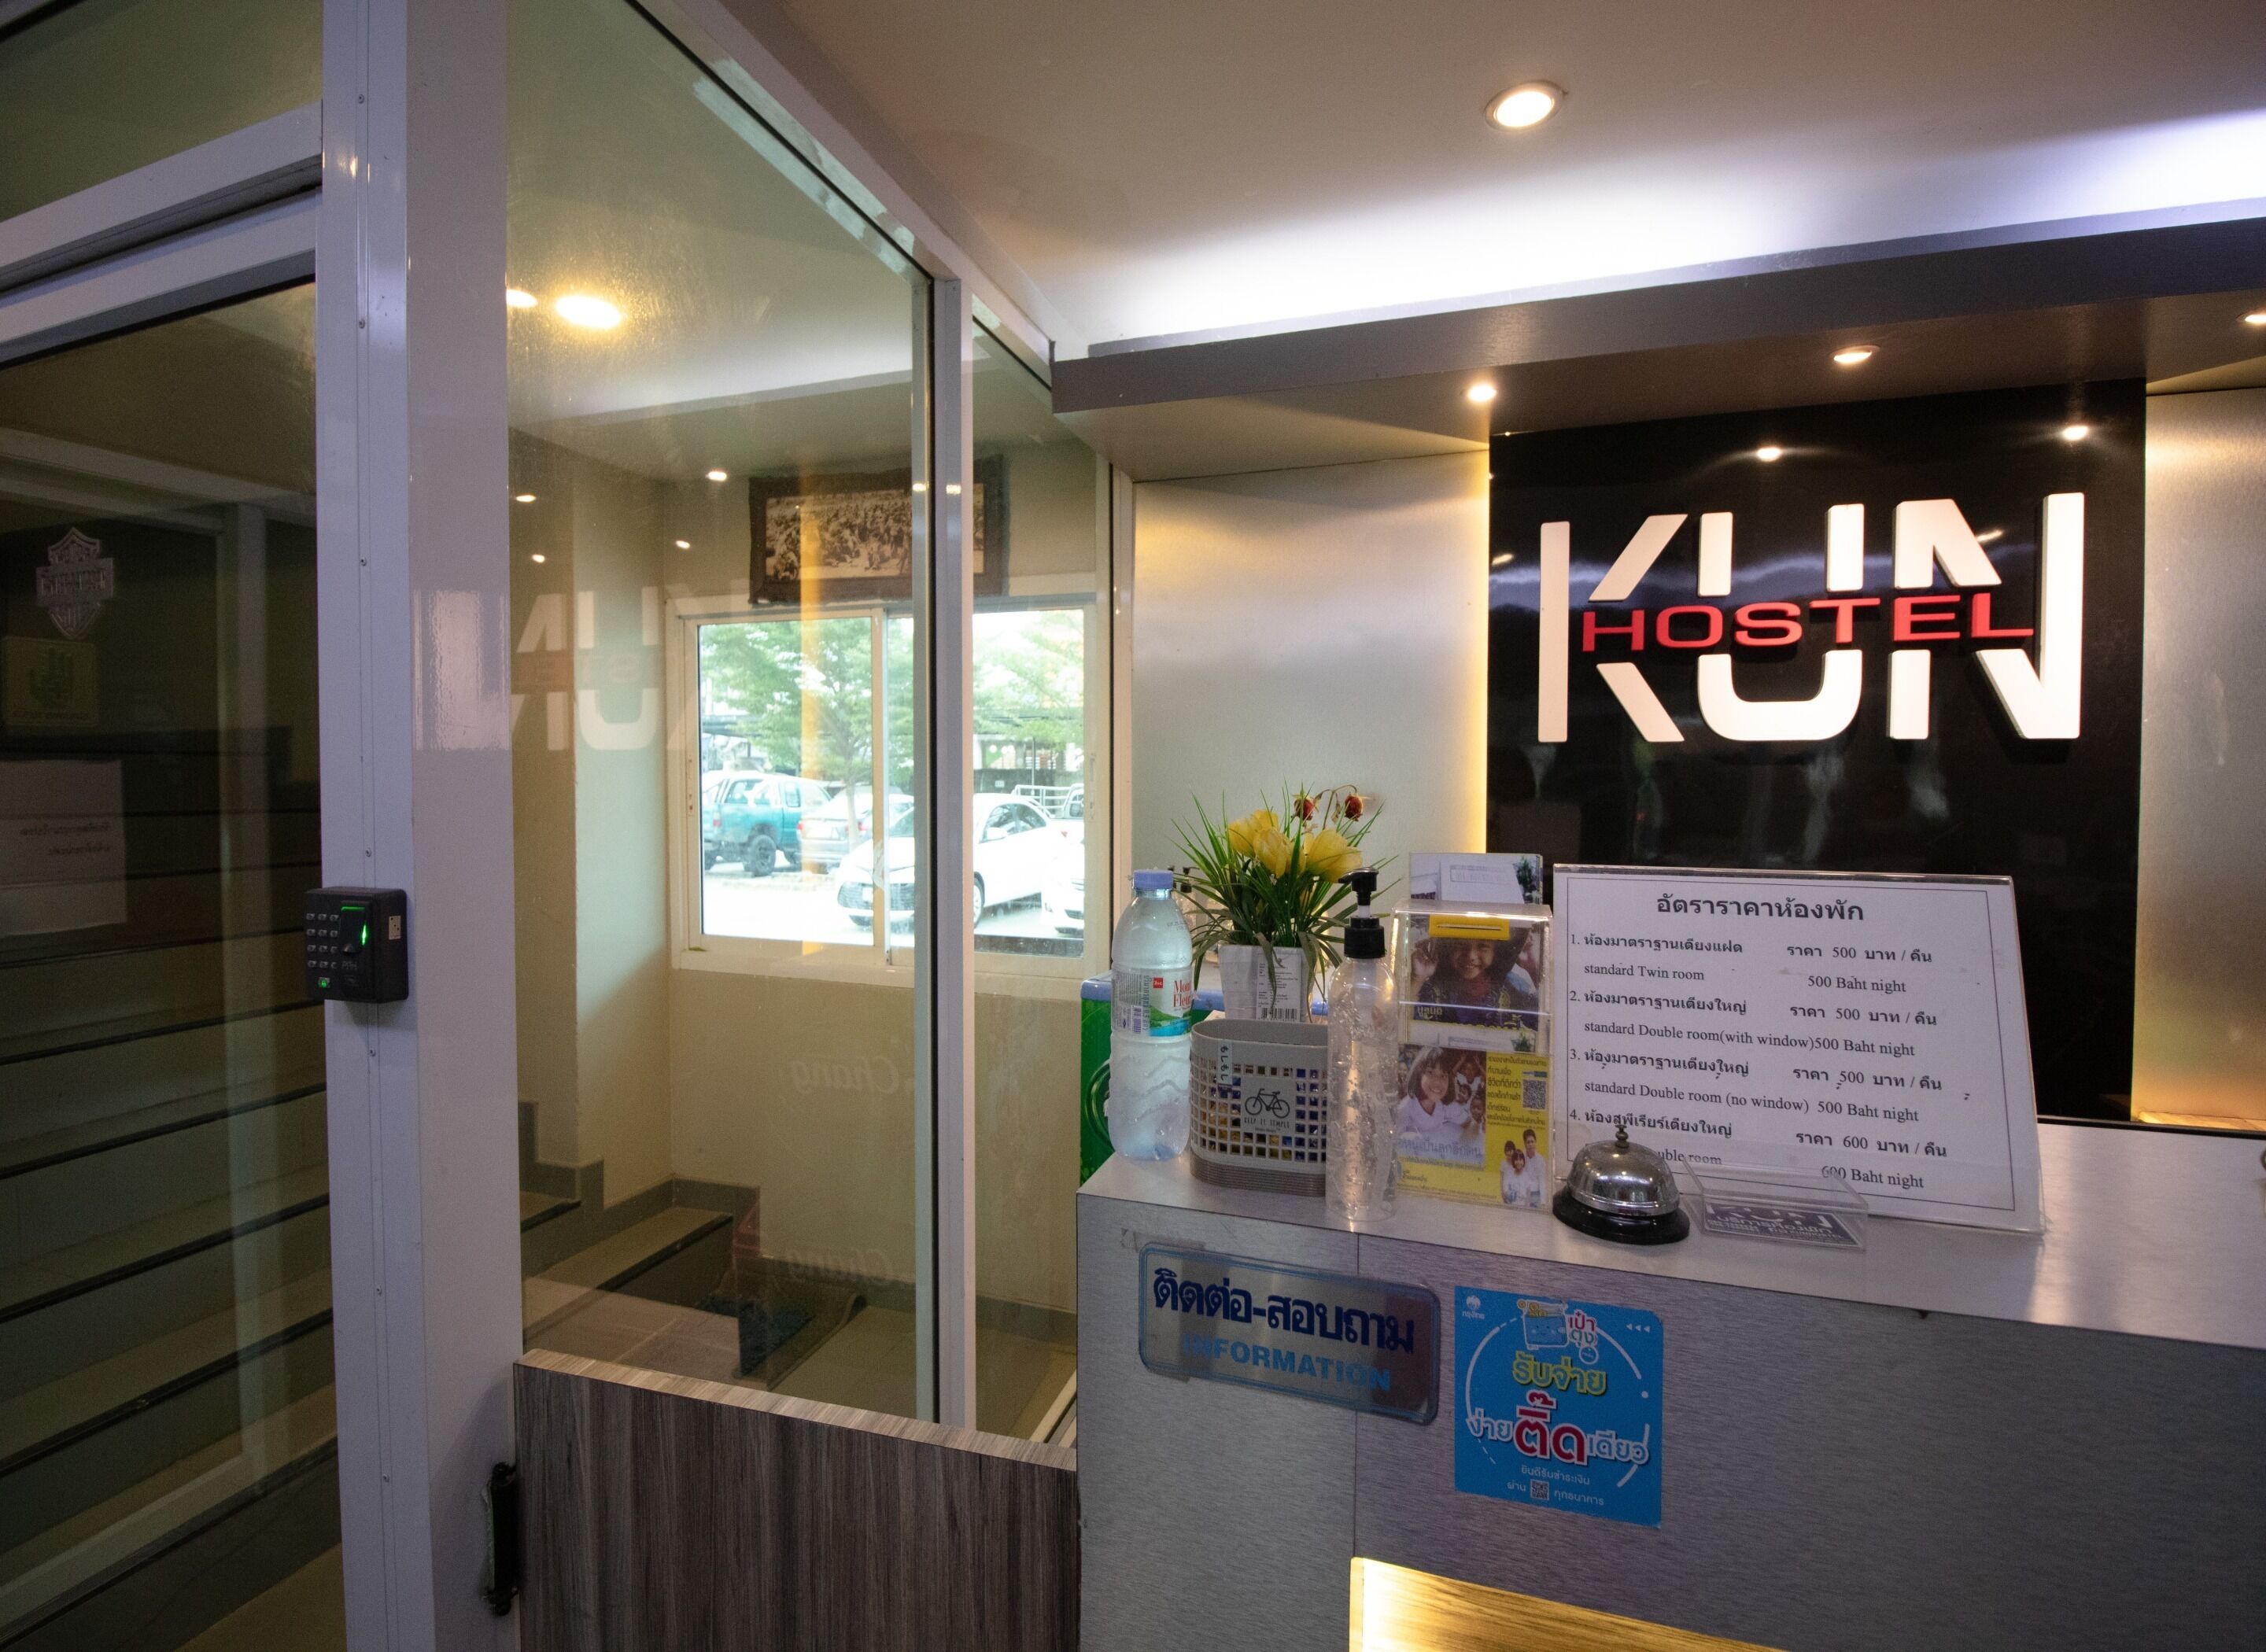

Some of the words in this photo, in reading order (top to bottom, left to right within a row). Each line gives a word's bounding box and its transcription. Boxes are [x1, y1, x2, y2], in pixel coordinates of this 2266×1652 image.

[1537, 492, 2085, 743] KUN
[1582, 592, 2034, 652] HOSTEL
[1656, 893, 1864, 920] อัตราราคาห้องพัก
[1584, 933, 1743, 953] ห้องมาตราฐานเตียงแฝด
[1787, 945, 1822, 957] ราคา
[1832, 946, 1857, 958] 500
[1864, 949, 1895, 961] บาท
[1910, 948, 1932, 963] คืน
[1584, 964, 1634, 976] standard
[1637, 965, 1669, 979] Twin
[1673, 970, 1705, 980] room
[1808, 975, 1832, 987] 500
[1836, 977, 1867, 990] Baht
[1871, 979, 1906, 994] night
[1584, 990, 1747, 1015] ห้องมาตราฐานเตียงใหญ่
[1790, 1006, 1825, 1018] ราคา
[1836, 1008, 1860, 1020] 500
[1869, 1011, 1900, 1023] บาท
[1914, 1011, 1937, 1026] คืน
[1584, 1022, 1635, 1034] standard
[1639, 1024, 1683, 1038] Double
[1843, 1039, 1875, 1053] Baht
[1879, 1042, 1915, 1057] night
[1584, 1048, 1749, 1077] ห้องมาตราฐานเตียงใหญ่
[1793, 1068, 1829, 1081] ราคา
[1840, 1071, 1865, 1084] 500
[1873, 1075, 1905, 1087] บาท
[1919, 1075, 1942, 1090] คืน
[1585, 1082, 1636, 1096] standard
[1640, 1085, 1685, 1101] Double
[1688, 1093, 1722, 1104] room
[1725, 1092, 1747, 1107] (no
[1751, 1096, 1810, 1115] window)
[1818, 1101, 1843, 1115] 500
[1847, 1104, 1879, 1118] Baht
[1883, 1108, 1920, 1123] night
[1796, 1132, 1832, 1146] ราคา
[1843, 1136, 1868, 1149] 600
[1877, 1140, 1909, 1154] บาท
[1924, 1141, 1947, 1157] คืน
[1657, 1149, 1685, 1162] uble
[1688, 1154, 1722, 1165] room
[1821, 1165, 1847, 1181] 600
[1851, 1169, 1884, 1184] Baht
[1888, 1172, 1925, 1189] night
[1153, 1267, 1415, 1355] ติดต่อ-สอบถาม
[1182, 1333, 1391, 1392] INFORMATION
[1512, 1350, 1607, 1395] รับจ่าย
